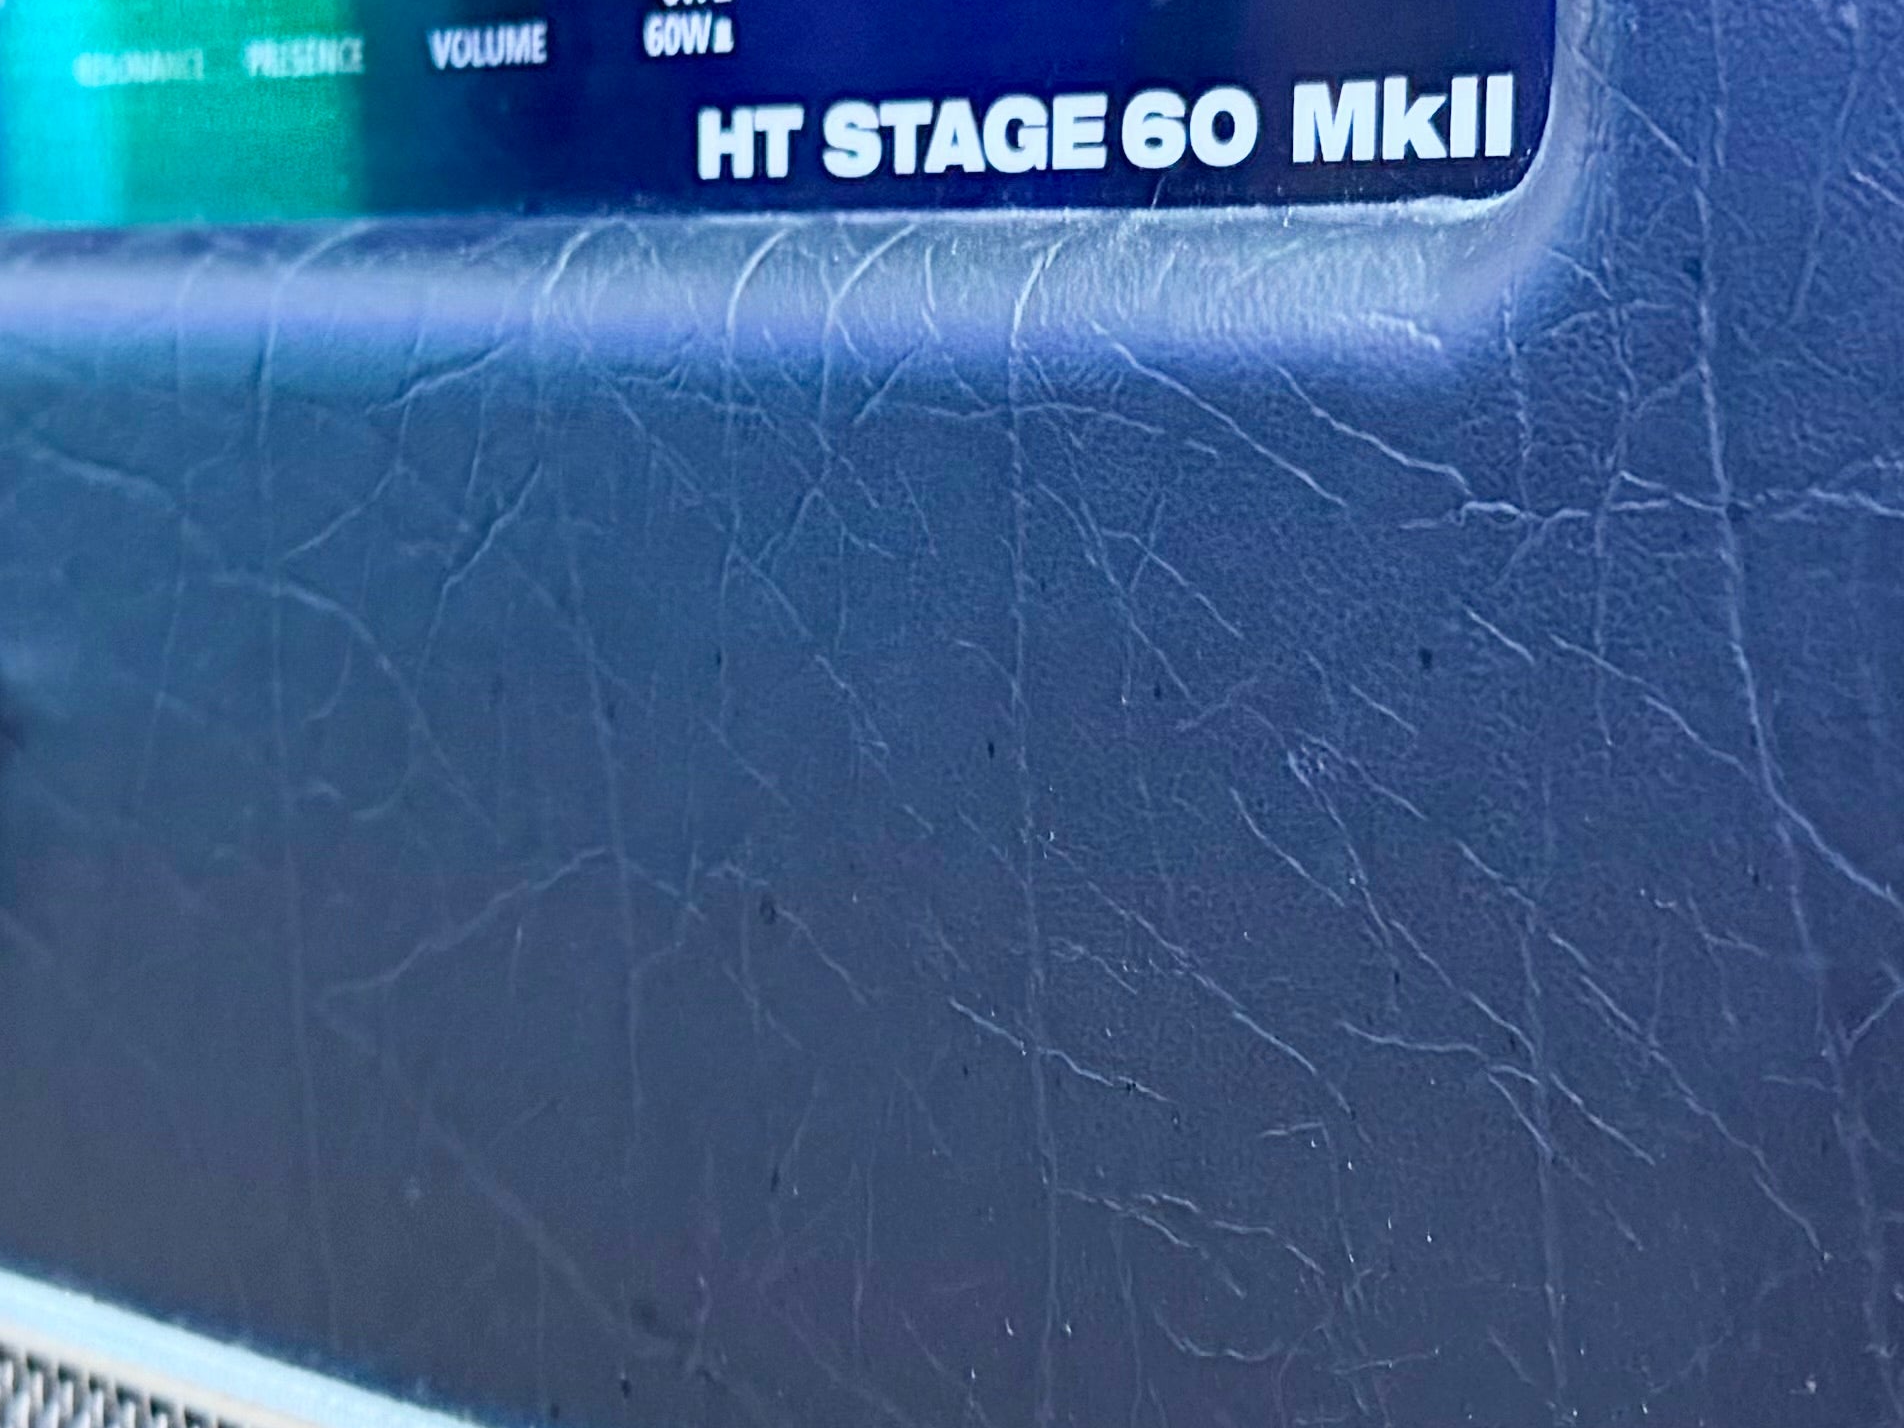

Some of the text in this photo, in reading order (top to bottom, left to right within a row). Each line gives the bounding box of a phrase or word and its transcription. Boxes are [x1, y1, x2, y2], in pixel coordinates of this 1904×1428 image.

[429, 21, 548, 70] VOLUME
[644, 11, 712, 57] 60W
[698, 73, 1514, 179] HT STAGE 60 MkII
